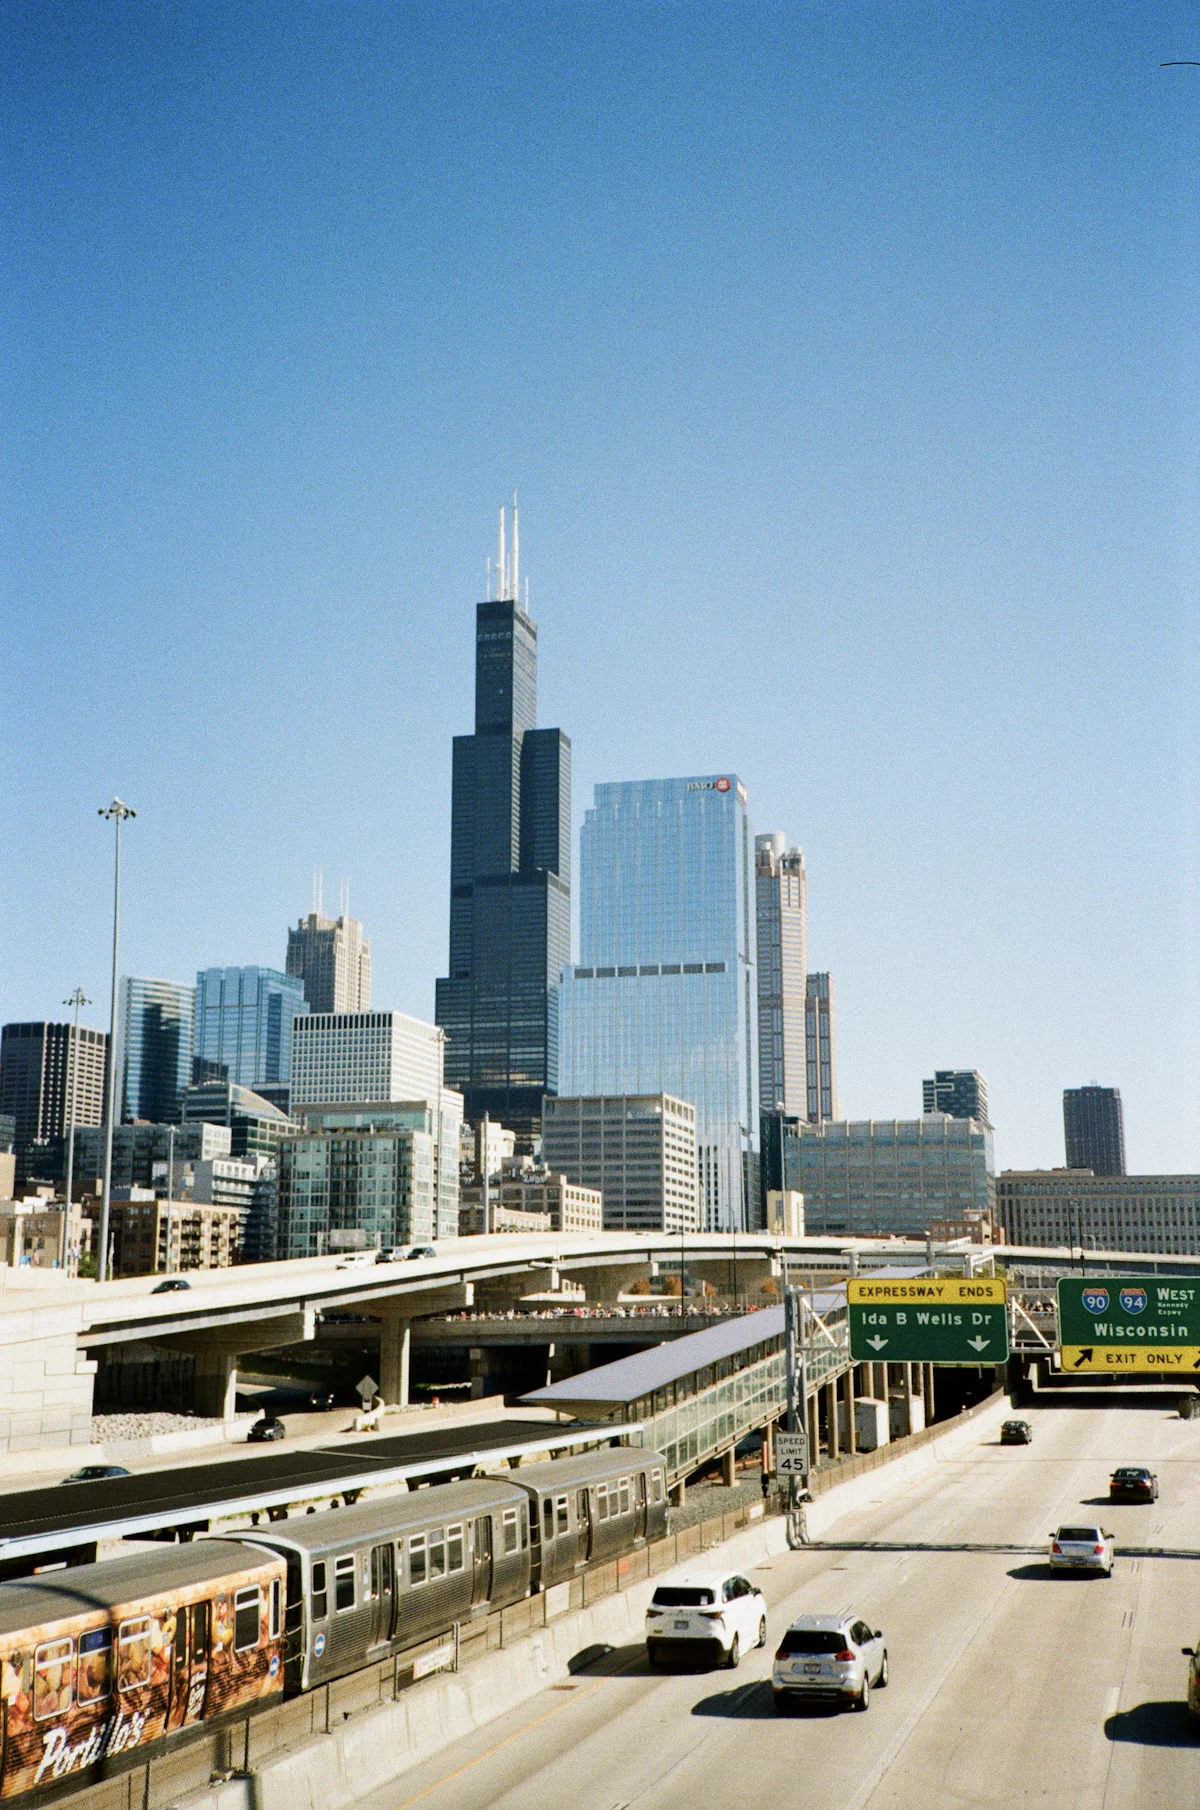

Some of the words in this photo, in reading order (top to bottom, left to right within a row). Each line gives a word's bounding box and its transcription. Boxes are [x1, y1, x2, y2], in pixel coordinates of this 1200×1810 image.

[859, 1287, 944, 1297] EXPRESSWAY
[959, 1286, 993, 1297] ENDS
[1157, 1288, 1195, 1300] WEST
[1086, 1296, 1105, 1309] 90
[1124, 1296, 1143, 1309] 94
[862, 1312, 887, 1325] Ida
[896, 1312, 907, 1325] B
[916, 1312, 962, 1325] Wells
[972, 1312, 992, 1325] Dr
[1094, 1323, 1188, 1337] Wisconsin
[1106, 1354, 1136, 1364] EXIT
[1147, 1353, 1183, 1364] ONLY
[778, 1437, 805, 1445] SPEED
[781, 1458, 803, 1470] 45
